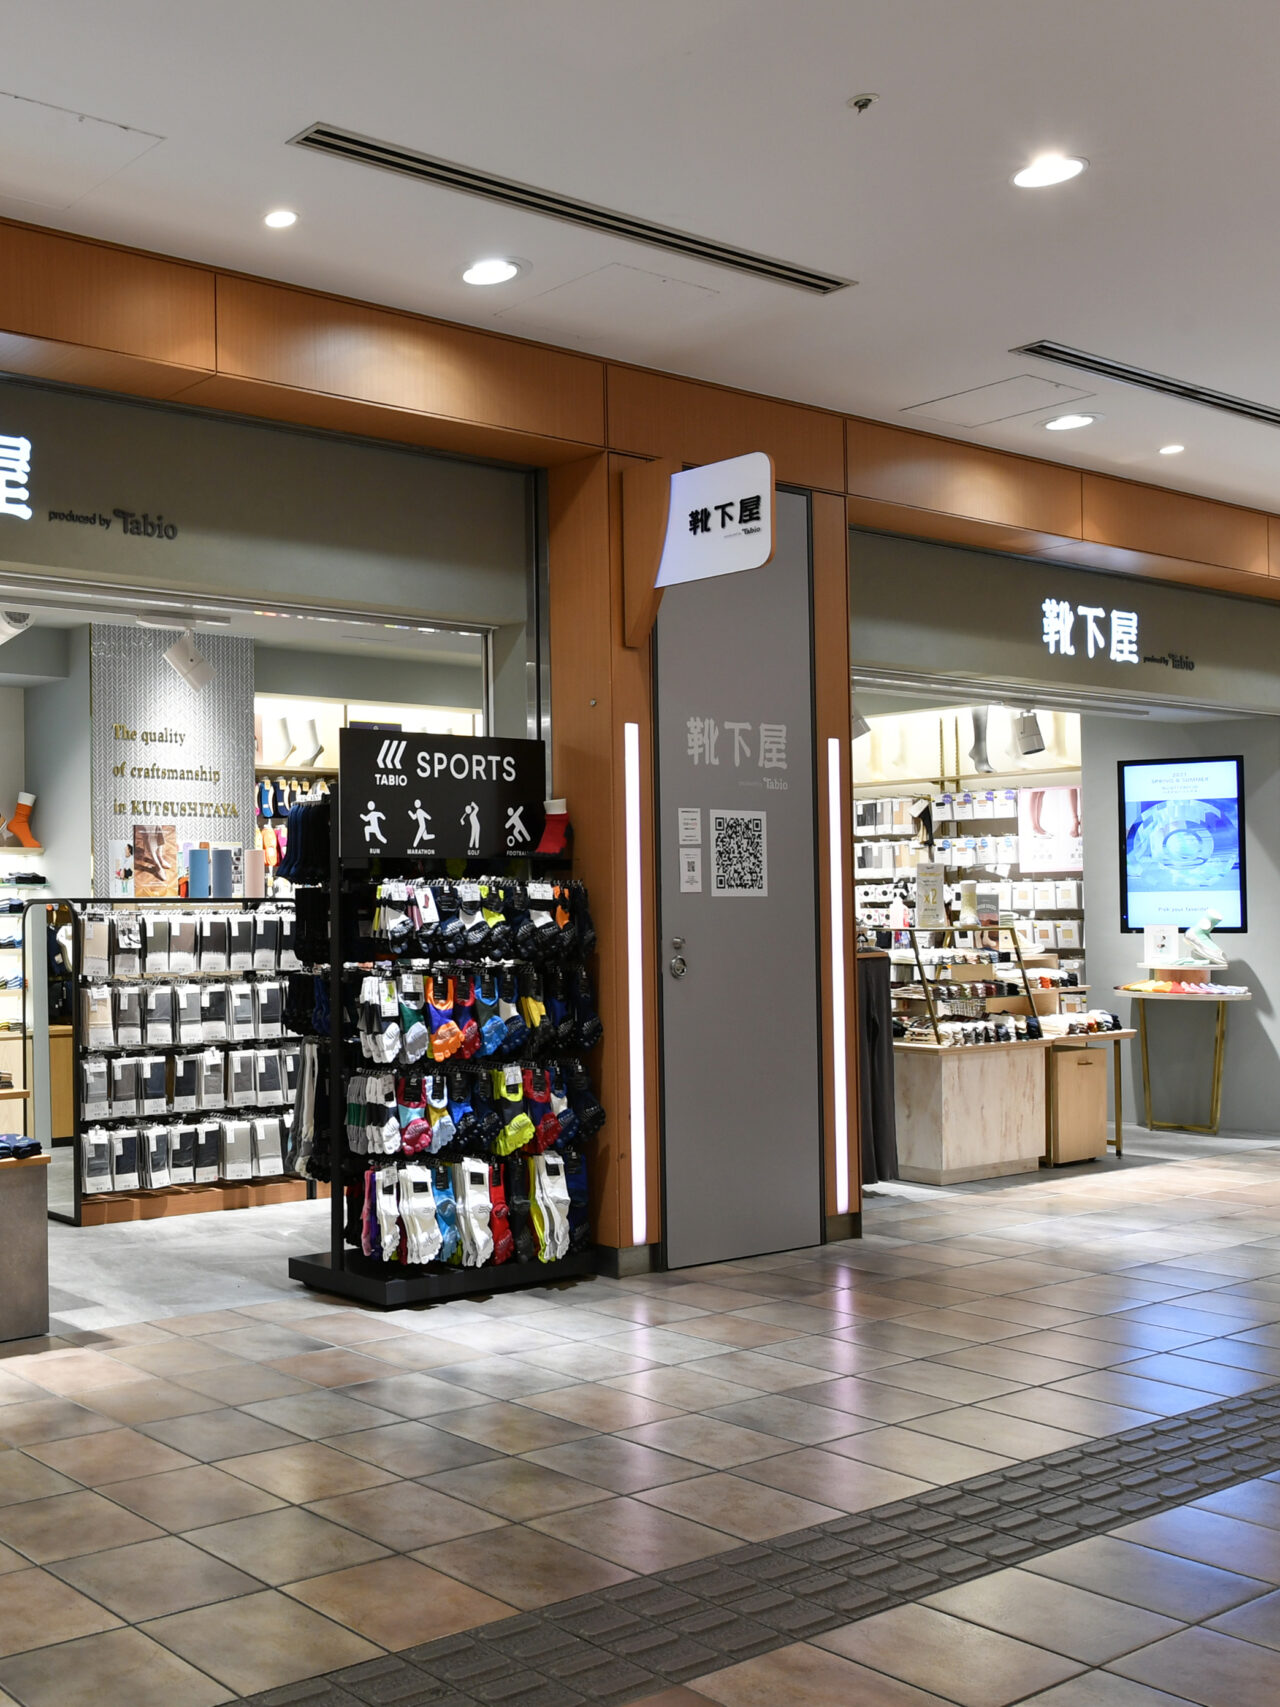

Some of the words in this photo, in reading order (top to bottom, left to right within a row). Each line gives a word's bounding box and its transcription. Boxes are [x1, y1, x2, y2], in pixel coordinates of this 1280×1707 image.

[48, 510, 96, 525] produced
[99, 514, 112, 529] by
[113, 508, 178, 540] Tabio
[688, 495, 762, 535] 靴下屋
[741, 526, 761, 535] Tabio
[1041, 598, 1140, 664] 靴下屋
[1168, 653, 1195, 671] Tabio
[113, 724, 138, 742] The
[141, 729, 186, 747] quality
[686, 716, 788, 770] 靴下屋
[113, 762, 126, 777] of
[130, 763, 221, 784] craftsmanship
[417, 751, 516, 782] SPORTS
[375, 774, 407, 786] TABIO
[763, 777, 788, 790] Tabio
[113, 799, 127, 815] in
[131, 800, 239, 818] KUTSUSHITAYA
